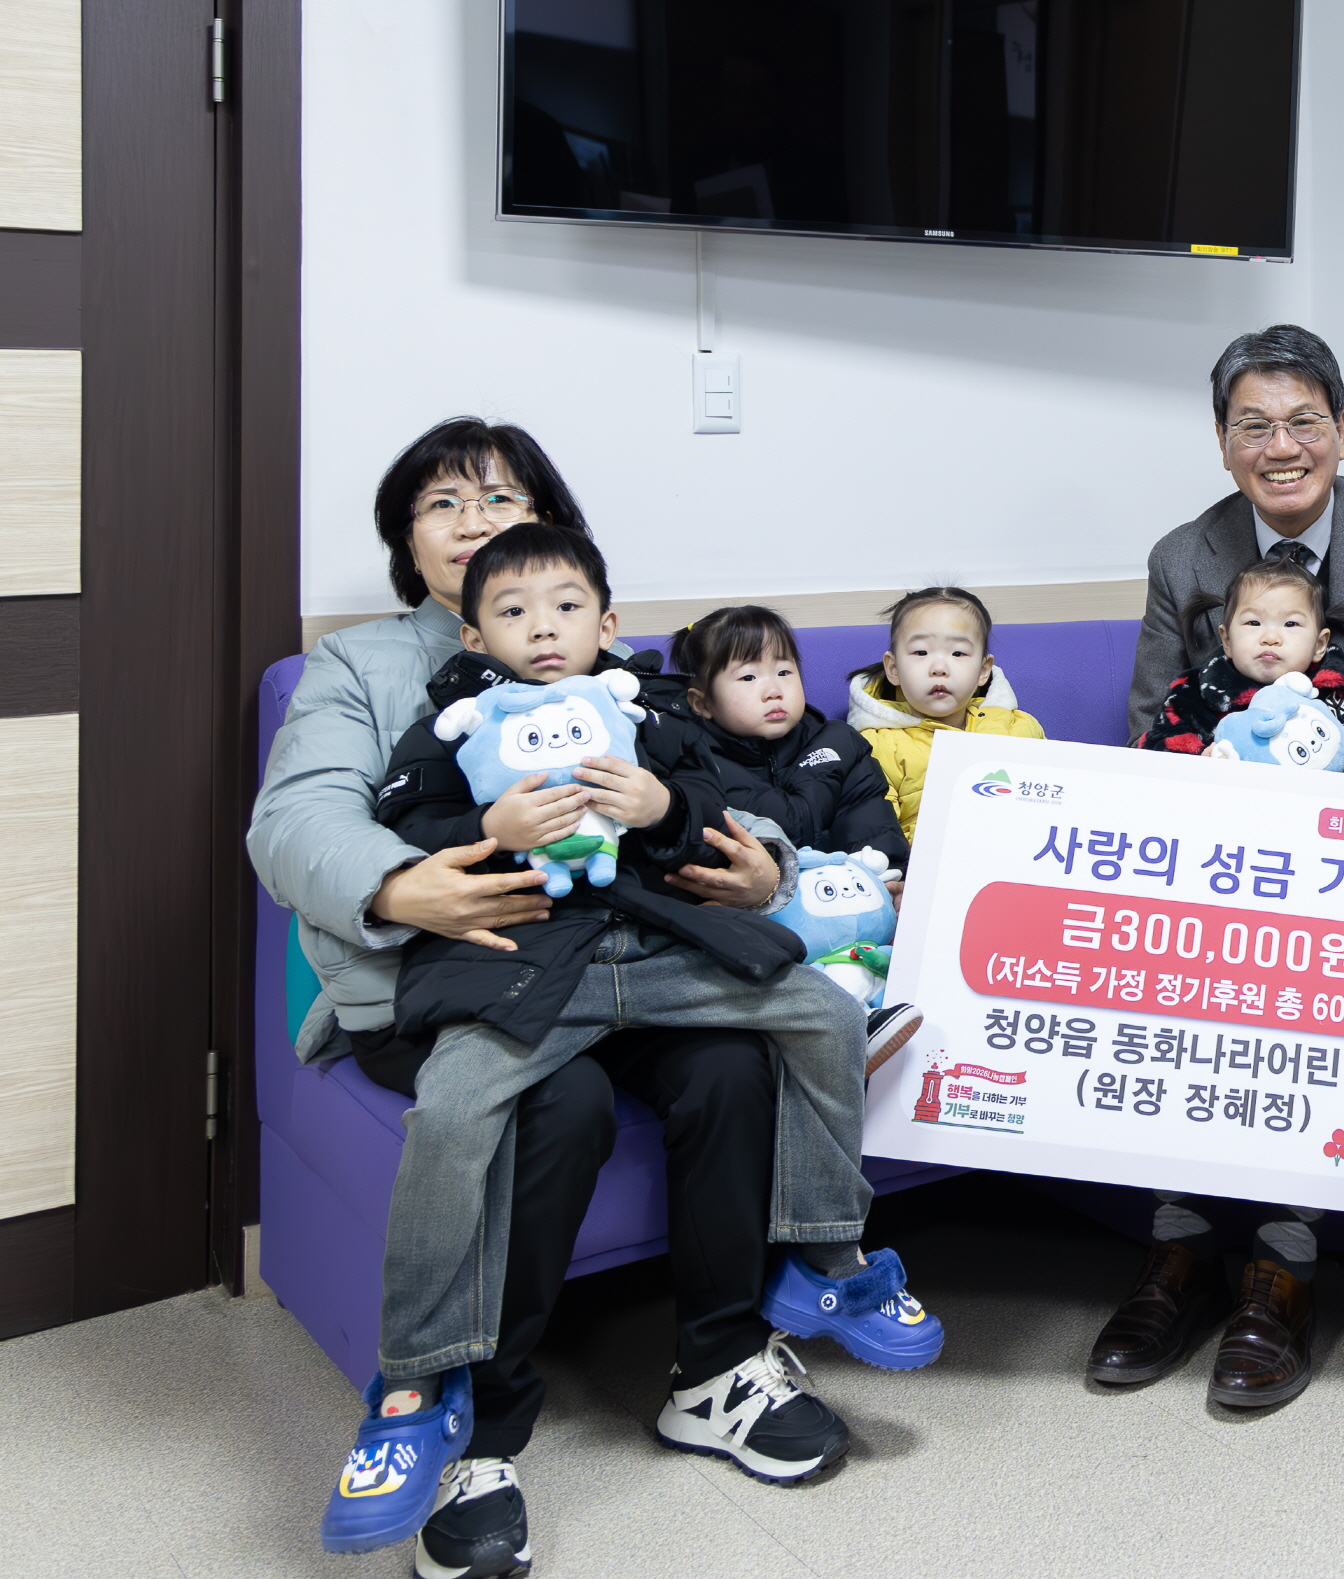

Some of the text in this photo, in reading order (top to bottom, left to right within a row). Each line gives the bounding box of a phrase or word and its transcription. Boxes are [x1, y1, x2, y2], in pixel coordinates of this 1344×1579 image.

[924, 229, 955, 238] SAMSUNG
[1017, 781, 1065, 799] 청양군
[1033, 826, 1180, 886] 사랑의
[1200, 844, 1296, 900] 성금
[986, 952, 1082, 995] (저소득
[1089, 966, 1147, 1001] 가정
[1155, 973, 1267, 1016] 정기후원
[1275, 986, 1304, 1021] 총
[984, 1011, 1098, 1060] 청양읍
[946, 1083, 1027, 1107] 행복을 더하는 기부
[1076, 1069, 1311, 1133] (원장 장혜정)
[944, 1102, 1025, 1125] 기부로 바꾸는 청양
